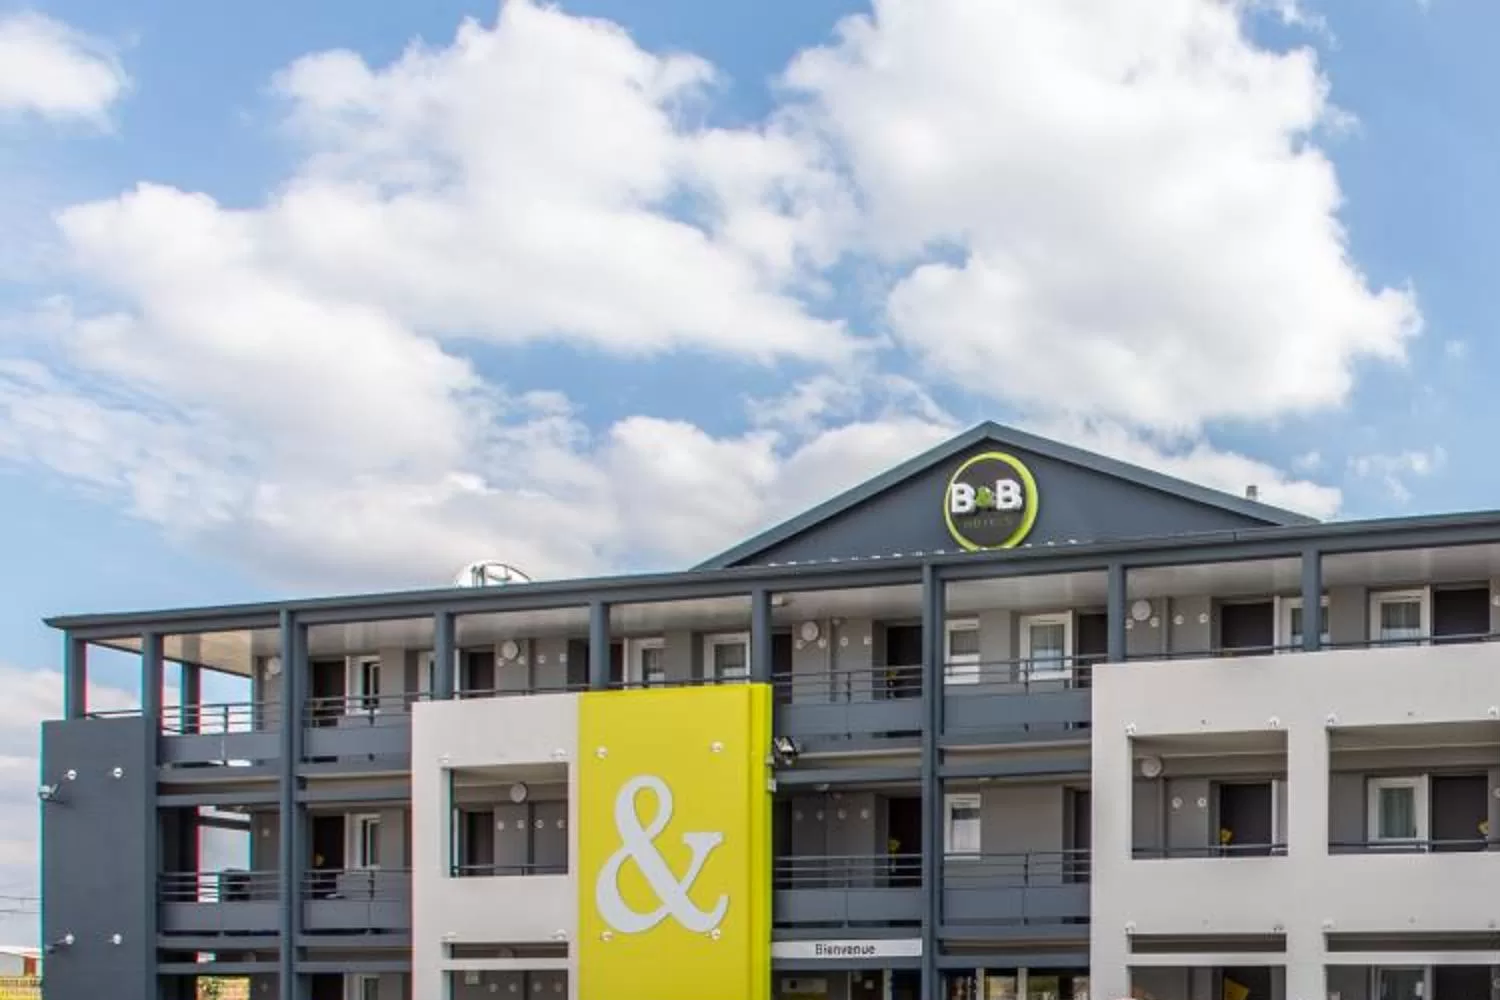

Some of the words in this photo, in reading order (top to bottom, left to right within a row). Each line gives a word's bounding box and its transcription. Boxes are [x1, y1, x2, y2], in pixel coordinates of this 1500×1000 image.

[951, 479, 1023, 513] B&B
[595, 774, 730, 933] &
[815, 943, 876, 955] Bienvenue
